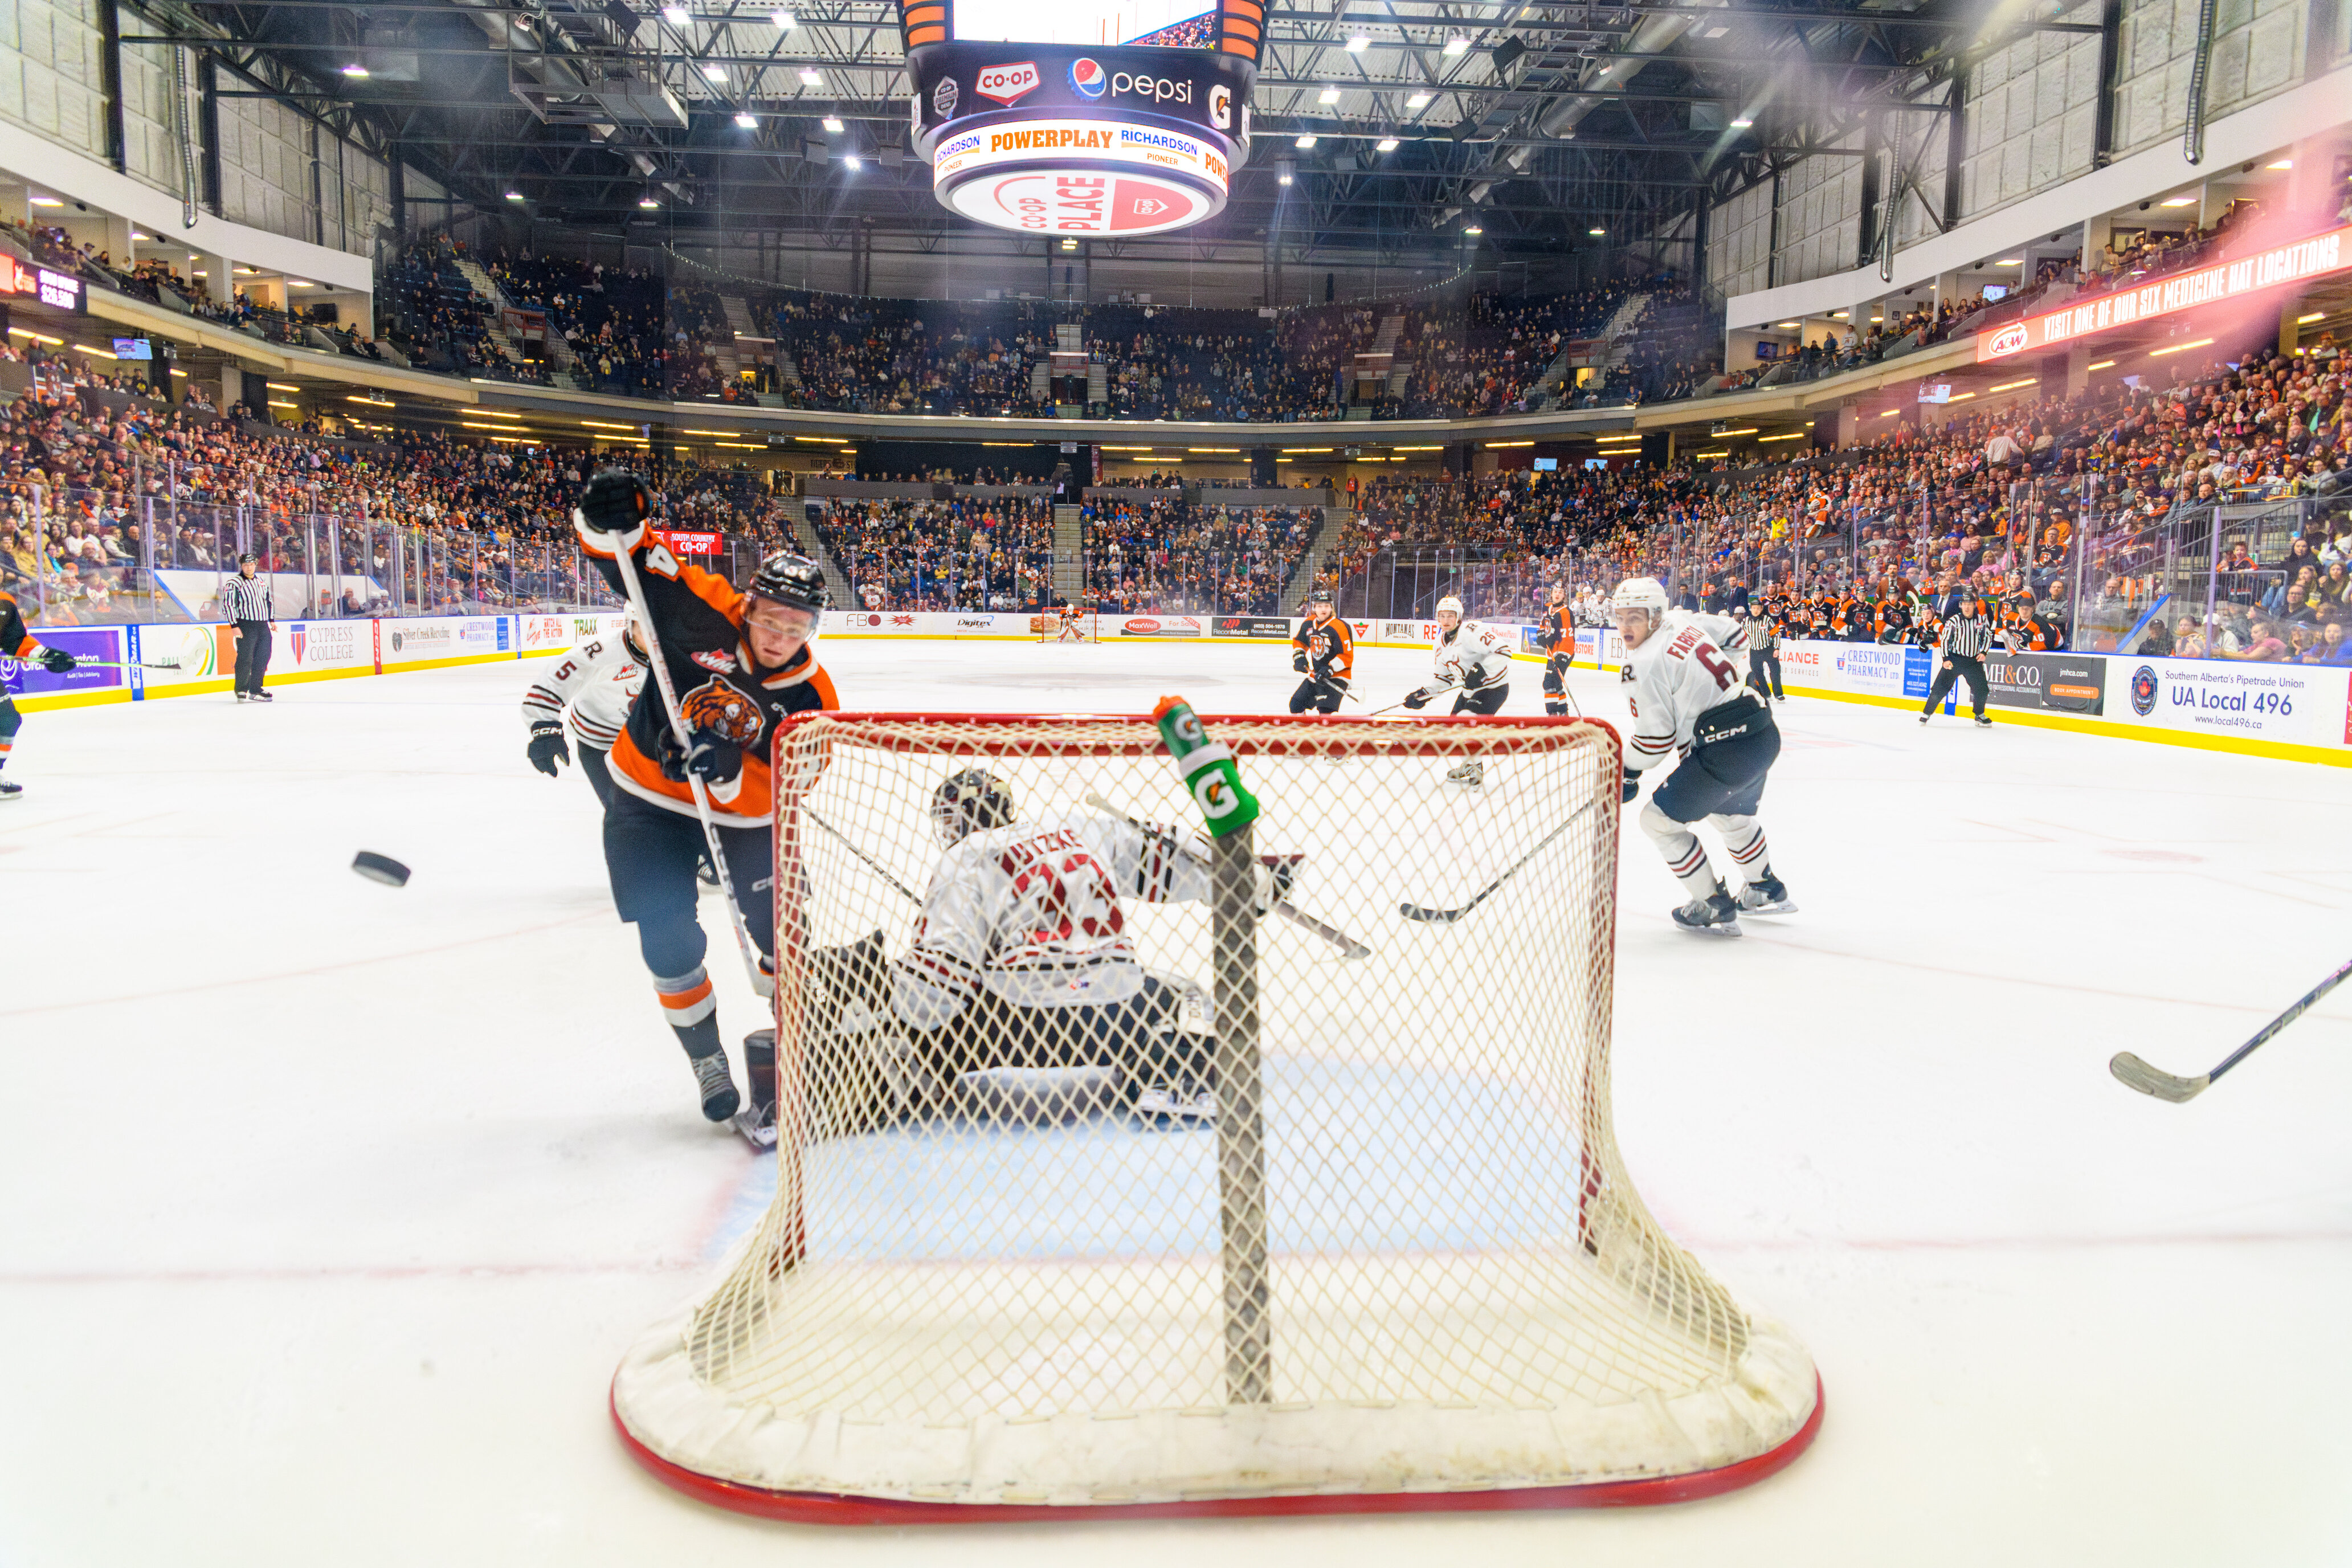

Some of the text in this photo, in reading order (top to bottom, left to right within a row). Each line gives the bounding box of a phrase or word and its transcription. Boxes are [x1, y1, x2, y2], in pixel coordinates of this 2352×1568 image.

[1112, 72, 1192, 104] pepsi
[1209, 84, 1231, 129] G
[937, 135, 980, 164] RICHARDSON
[991, 129, 1113, 153] POWERPLAY
[1121, 127, 1197, 156] RICHARDSON
[944, 160, 962, 172] PIONEER
[1147, 153, 1178, 166] PIONEER
[1056, 177, 1105, 230] PLACE
[2044, 234, 2339, 342] VISIT ONE OF OUR SIX MEDICINE HAT LOCATIONS
[1994, 333, 2024, 352] A&W
[671, 533, 690, 541] SOUTH
[680, 542, 708, 553] CO-OP
[466, 622, 495, 631] CRESTWOOD
[574, 617, 597, 643] TRAXX
[957, 618, 990, 627] Digitex
[1186, 617, 1199, 627] SOLD
[309, 626, 353, 643] CYPRESS
[402, 626, 450, 640] Silver Creek Recycling
[467, 632, 489, 642] PHARMACY
[551, 627, 563, 638] ACTION
[1480, 631, 1496, 647] 26
[1508, 630, 1517, 639] Pizza
[1560, 627, 1574, 638] 72
[310, 644, 354, 662] COLLEGE
[1848, 650, 1901, 665] CRESTWOOD
[556, 660, 577, 680] 5
[699, 651, 737, 674] WHL
[1695, 642, 1739, 692] 6
[618, 667, 638, 679] WHL
[1622, 664, 1637, 682] R
[1791, 668, 1819, 677] SERVICES
[1847, 664, 1888, 679] PHARMACY
[2060, 668, 2088, 677] jmhca.com
[2166, 671, 2304, 688] Southern Alberta's Pipetrade Union
[1630, 697, 1639, 718] 6
[2173, 686, 2196, 707] UA
[2202, 688, 2247, 711] Local
[2253, 692, 2292, 716] 496
[1174, 712, 1202, 740] G
[2195, 716, 2262, 729] www.local496.ca
[532, 727, 562, 736] CCM
[1704, 724, 1747, 743] CCM
[1194, 768, 1239, 819] G
